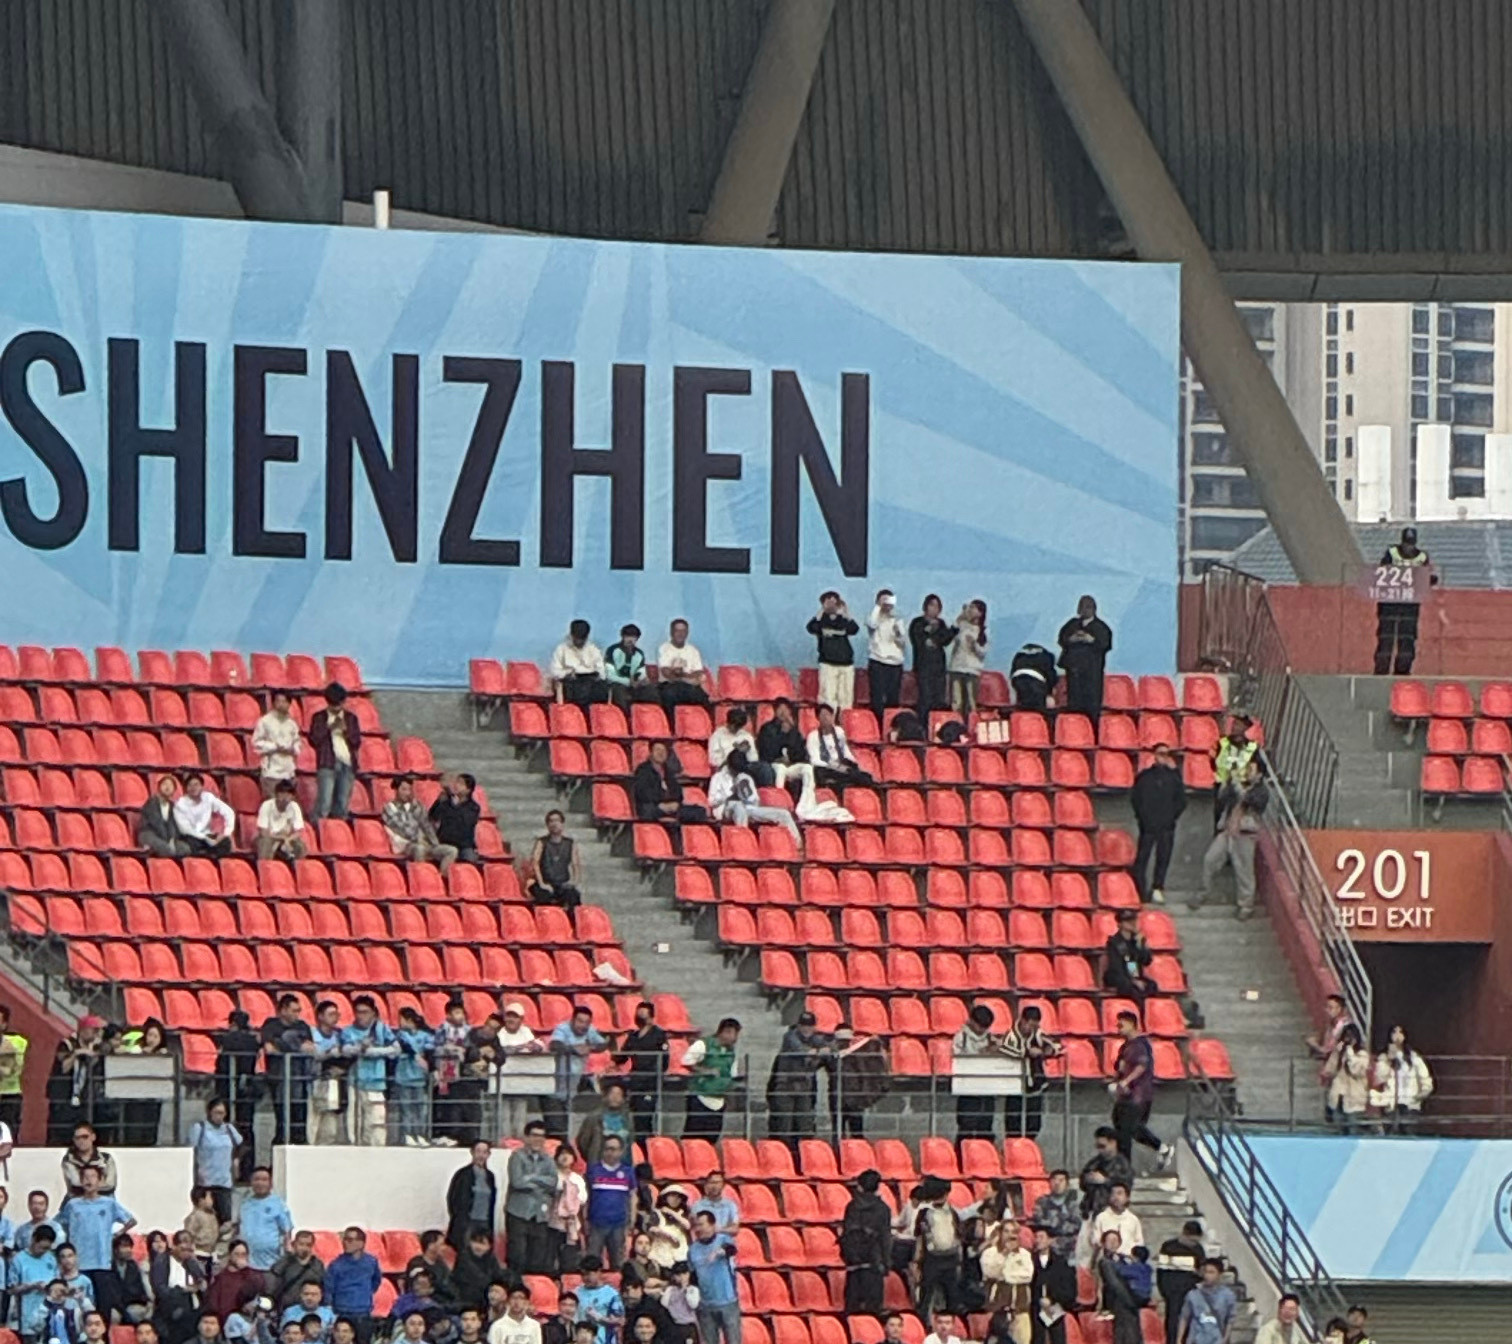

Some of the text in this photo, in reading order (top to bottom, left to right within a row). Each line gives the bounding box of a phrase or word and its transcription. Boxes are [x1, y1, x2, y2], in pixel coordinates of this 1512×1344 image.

[0, 330, 870, 578] SHENZHEN
[1375, 566, 1413, 586] 224
[1335, 848, 1431, 900] 201
[1386, 906, 1436, 928] EXIT
